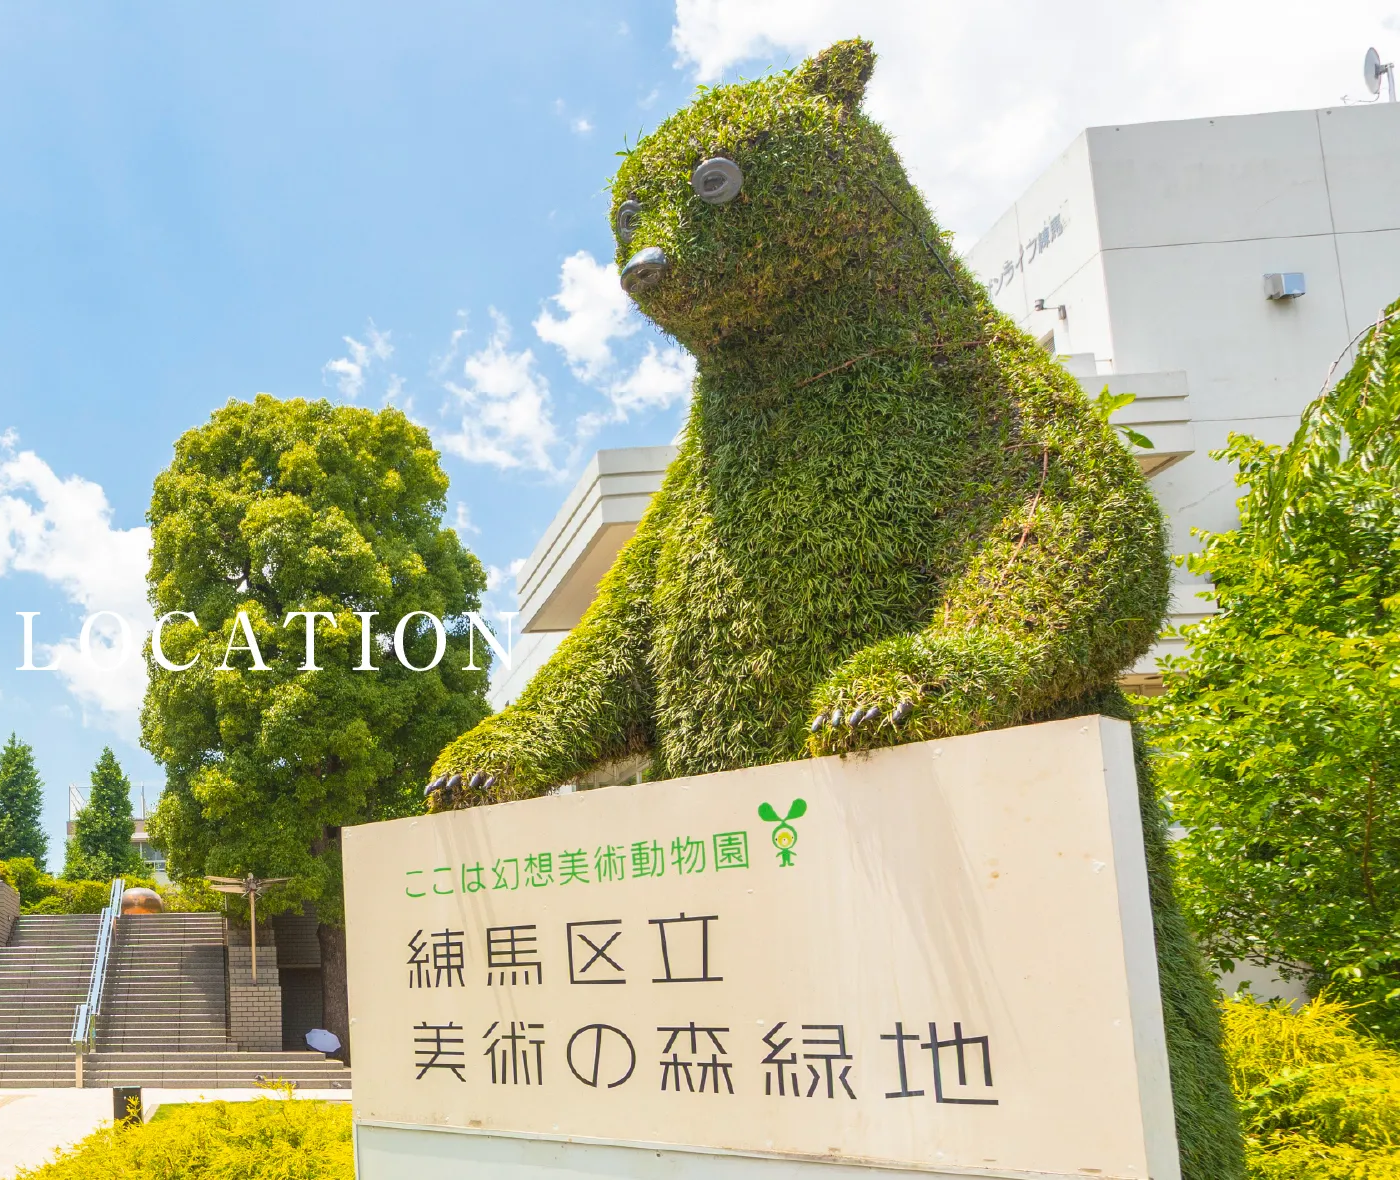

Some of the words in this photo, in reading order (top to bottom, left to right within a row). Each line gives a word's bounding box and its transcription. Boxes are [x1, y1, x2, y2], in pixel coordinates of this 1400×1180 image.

[404, 830, 750, 898] ここは幻想美術動物園
[406, 912, 724, 989] 練馬区立
[413, 1021, 999, 1105] 美術の森緑地
